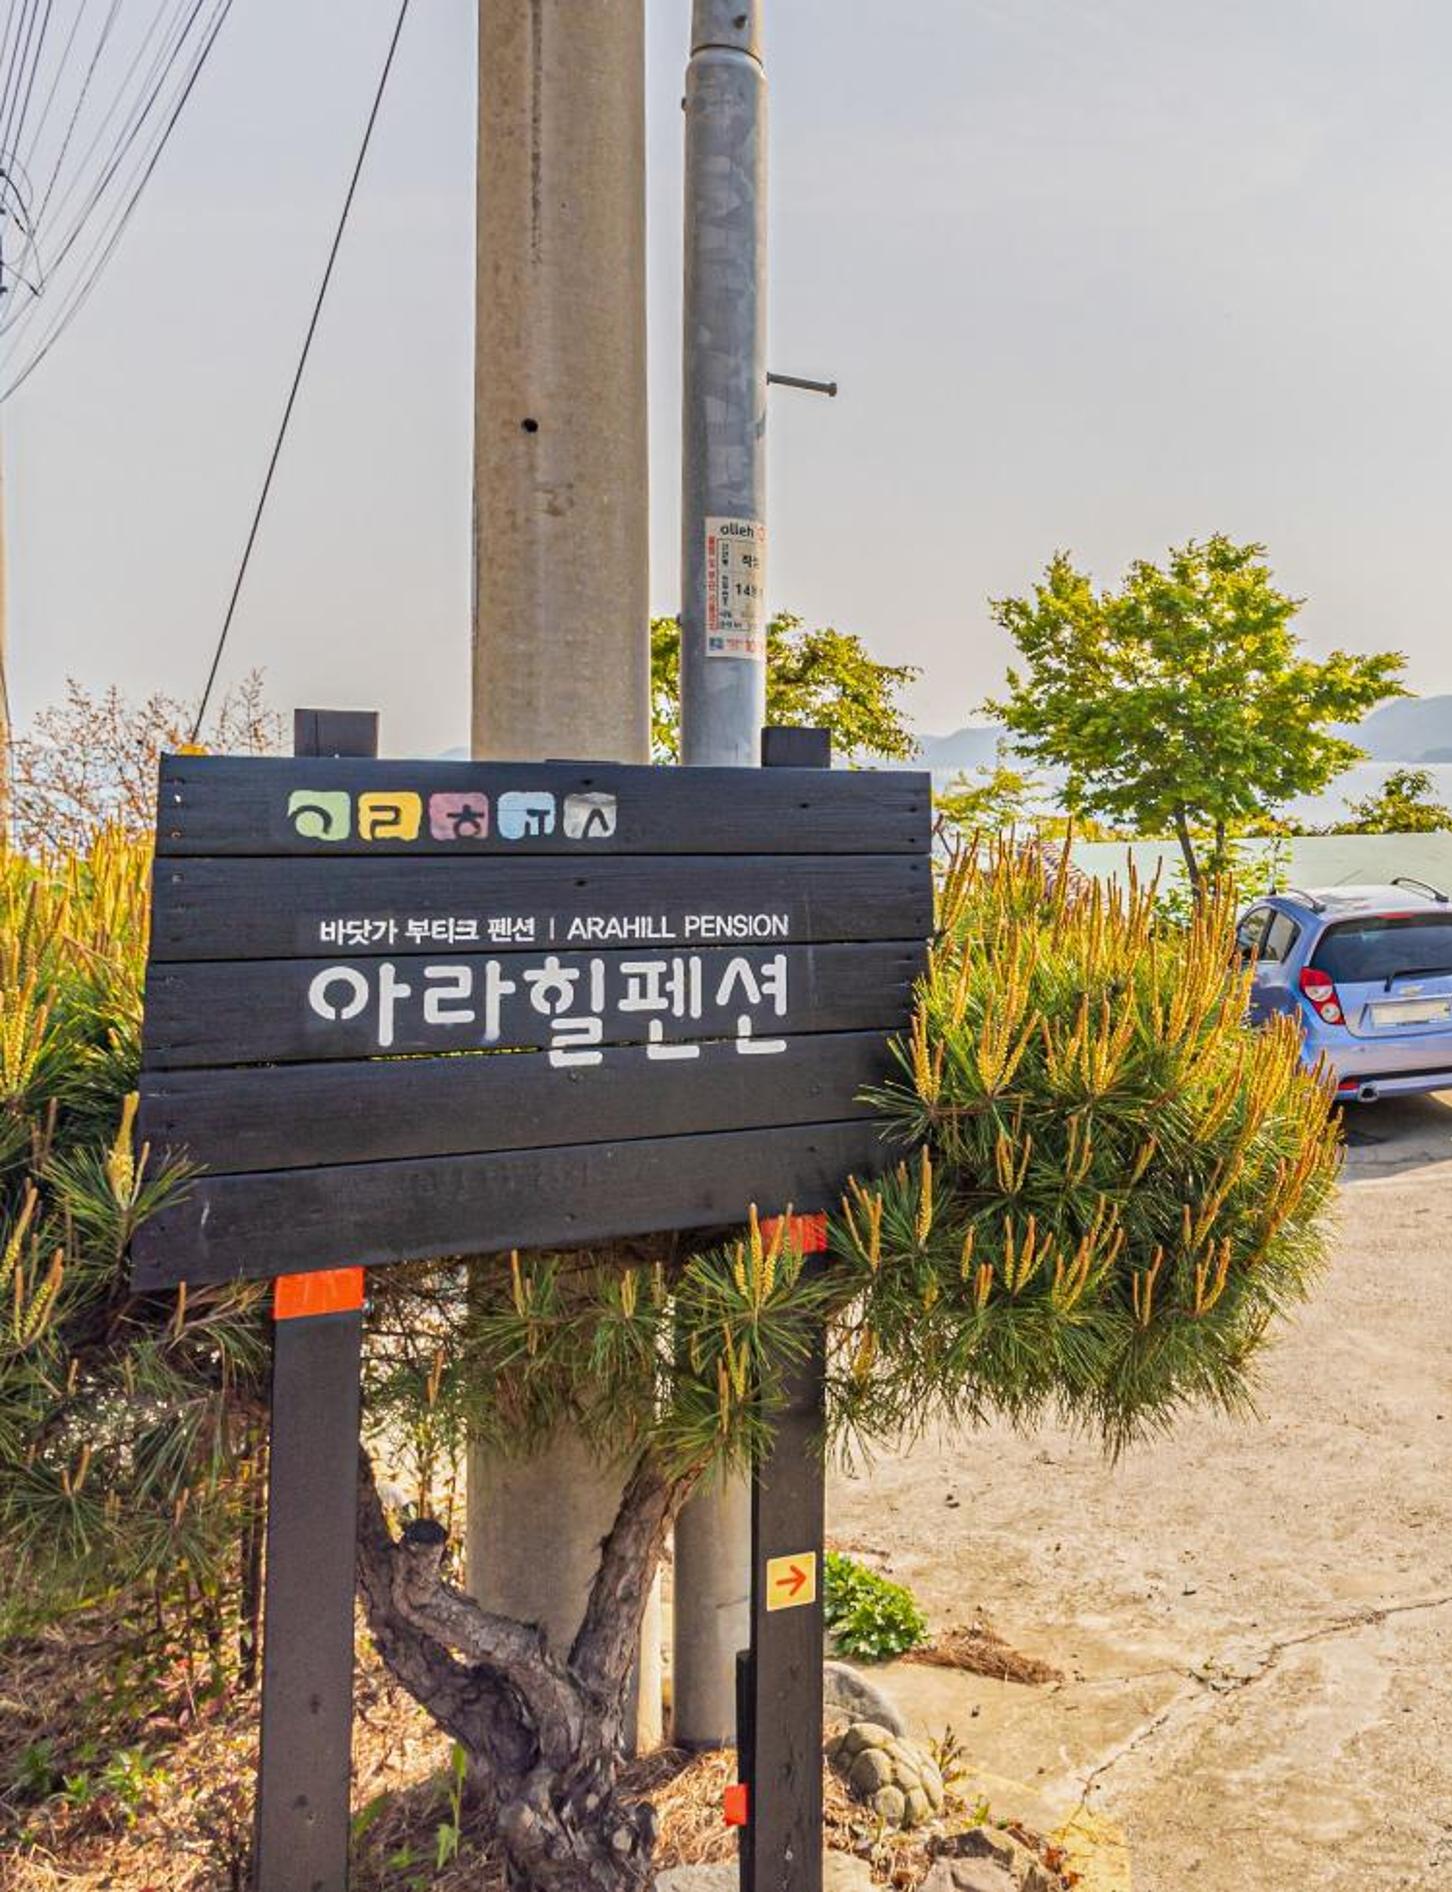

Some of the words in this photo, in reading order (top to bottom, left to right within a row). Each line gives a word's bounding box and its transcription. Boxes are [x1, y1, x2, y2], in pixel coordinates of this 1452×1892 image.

[720, 521, 755, 539] olleh
[319, 918, 398, 946] 바닷가
[404, 917, 480, 944] 부티크
[487, 916, 536, 942] 펜션
[567, 915, 676, 940] ARAHILL
[684, 913, 789, 938] PENSION
[308, 954, 788, 1069] 아라힐펜션
